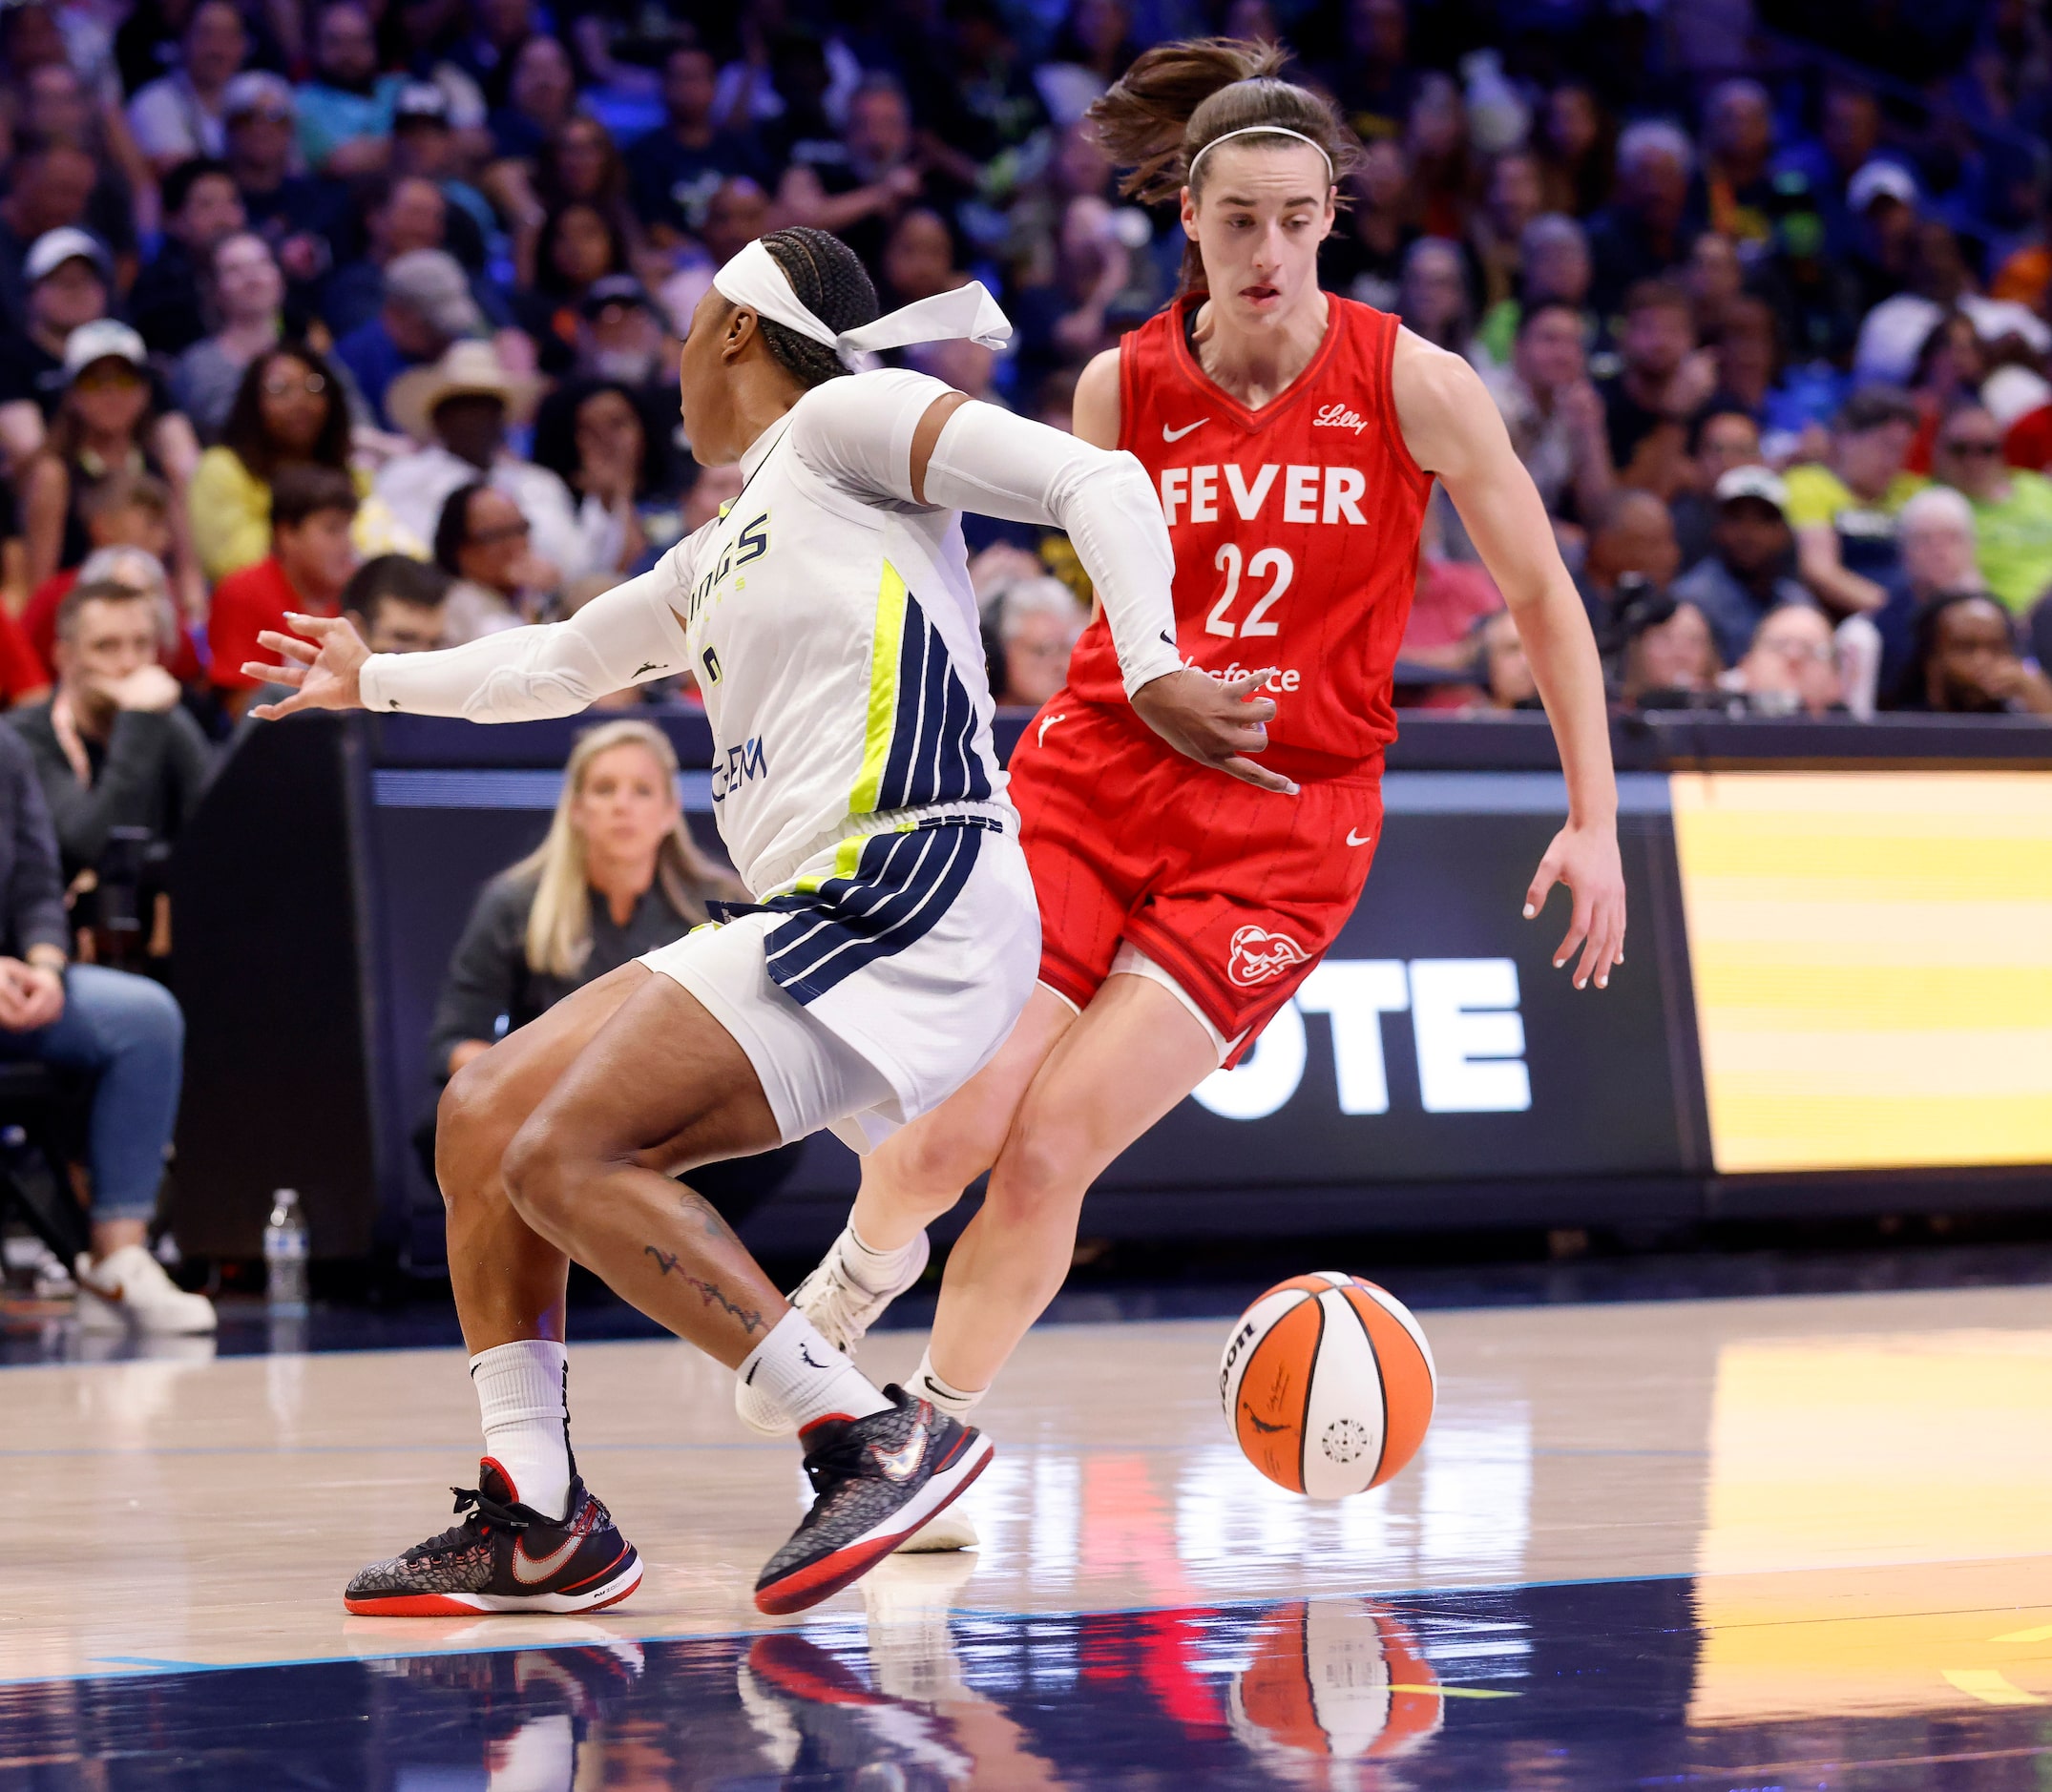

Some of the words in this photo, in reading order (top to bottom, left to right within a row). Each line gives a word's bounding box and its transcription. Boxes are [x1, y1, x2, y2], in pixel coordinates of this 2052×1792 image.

[1313, 404, 1368, 435] Lilly
[1160, 463, 1369, 526] FEVER
[1204, 542, 1294, 638] 22
[1190, 957, 1532, 1120] OTE
